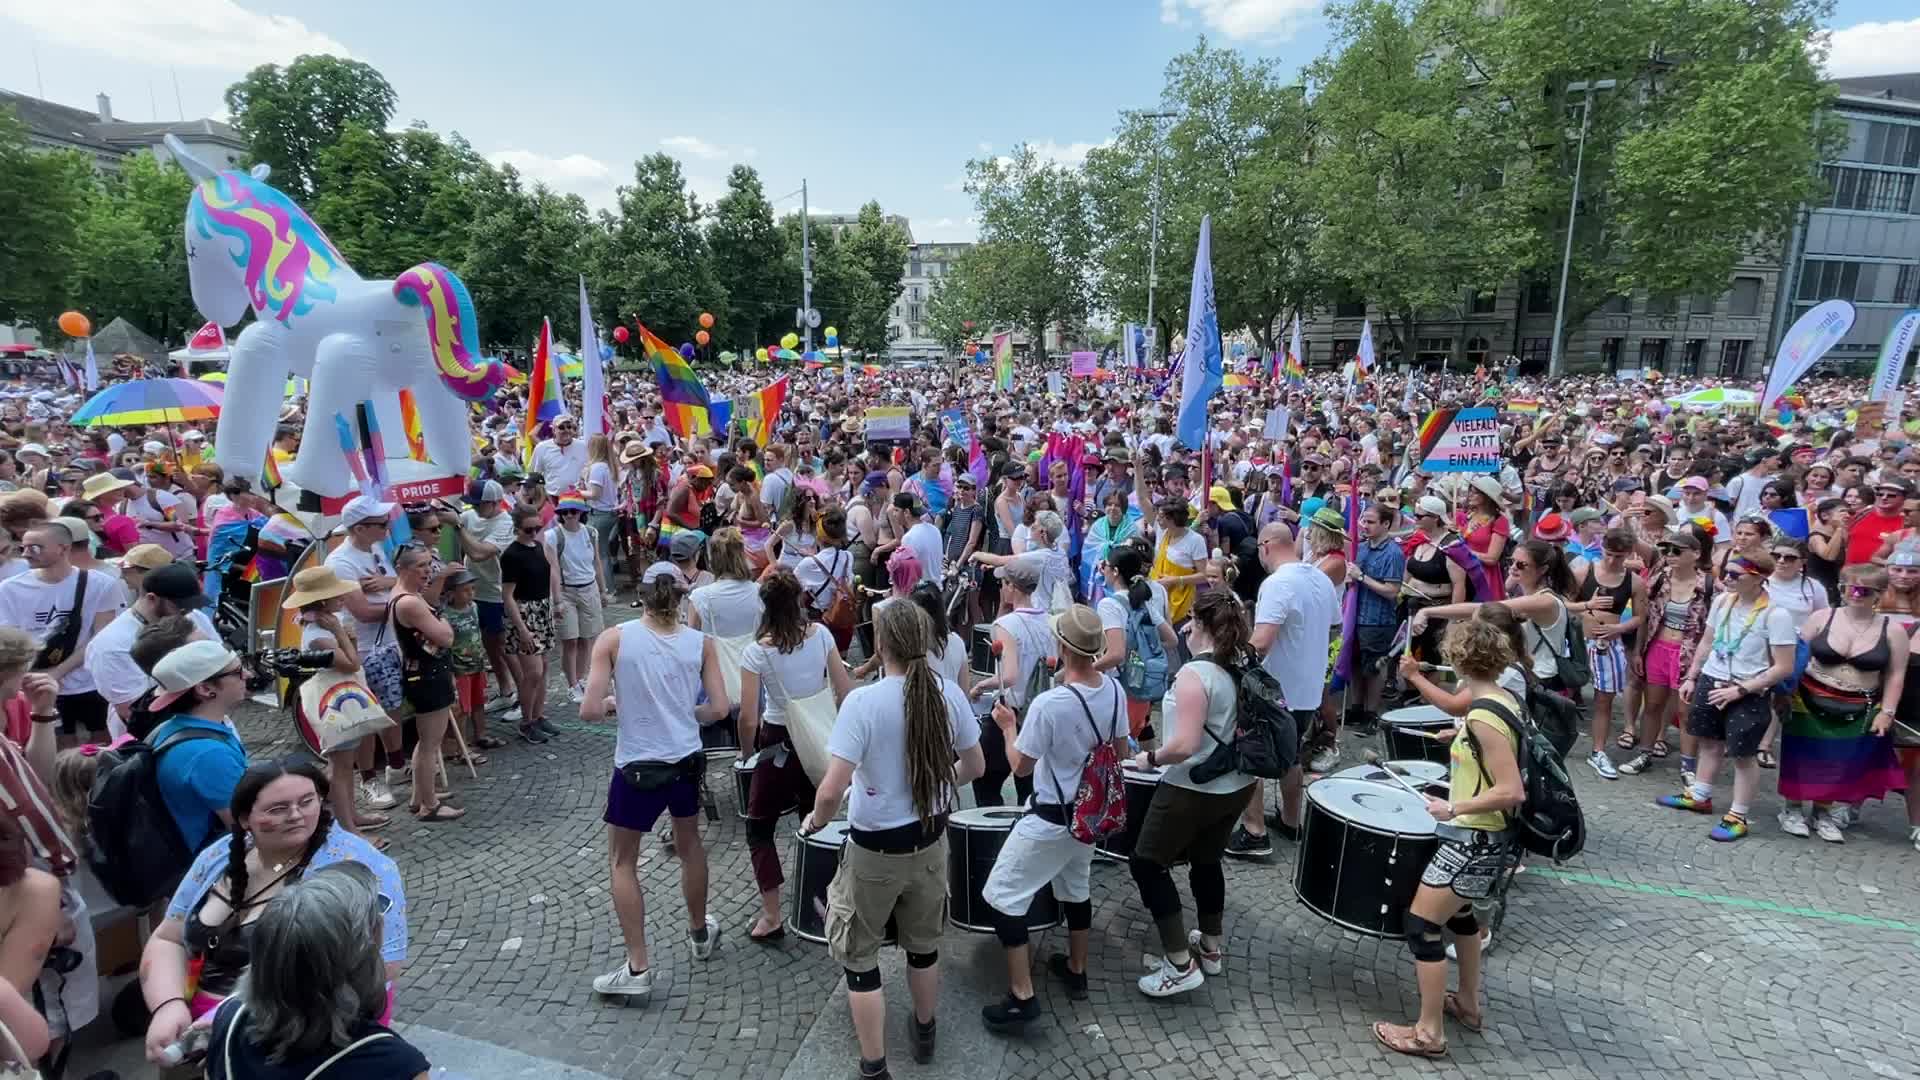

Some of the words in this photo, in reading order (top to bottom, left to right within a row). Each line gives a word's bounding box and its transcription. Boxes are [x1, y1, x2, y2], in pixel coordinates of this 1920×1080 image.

[1455, 417, 1496, 432] VIELFALT
[1460, 435, 1495, 448] STATT
[1449, 452, 1500, 466] EINFALT
[401, 483, 440, 498] PRIDE
